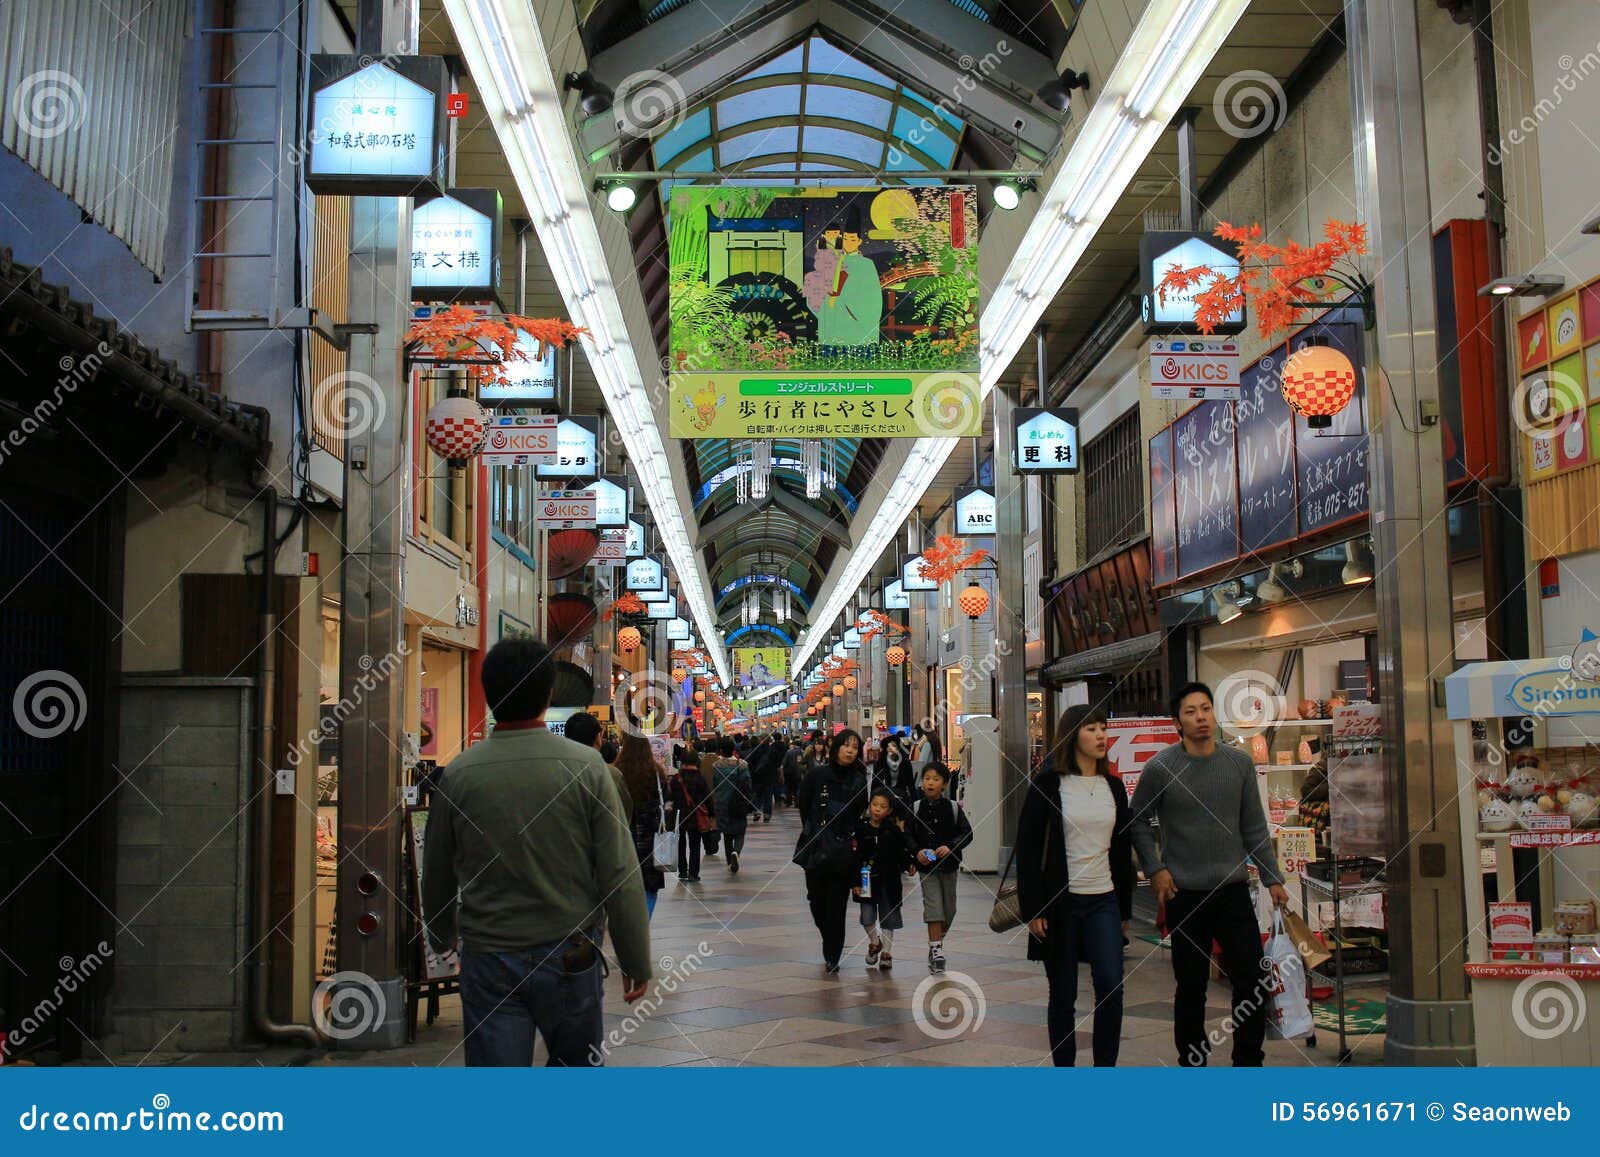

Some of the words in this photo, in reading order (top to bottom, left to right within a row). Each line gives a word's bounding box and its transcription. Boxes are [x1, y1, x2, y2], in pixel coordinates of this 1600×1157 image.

[328, 132, 416, 149] 和泉式部の石塔
[1183, 363, 1228, 380] KICS
[777, 382, 874, 393] エンジェルストリート
[738, 400, 915, 419] 歩行者にやさしく
[510, 434, 548, 449] KICS
[1023, 445, 1072, 462] 更科
[558, 505, 589, 516] KICS
[968, 514, 993, 523] ABC
[1471, 967, 1499, 976] Merry
